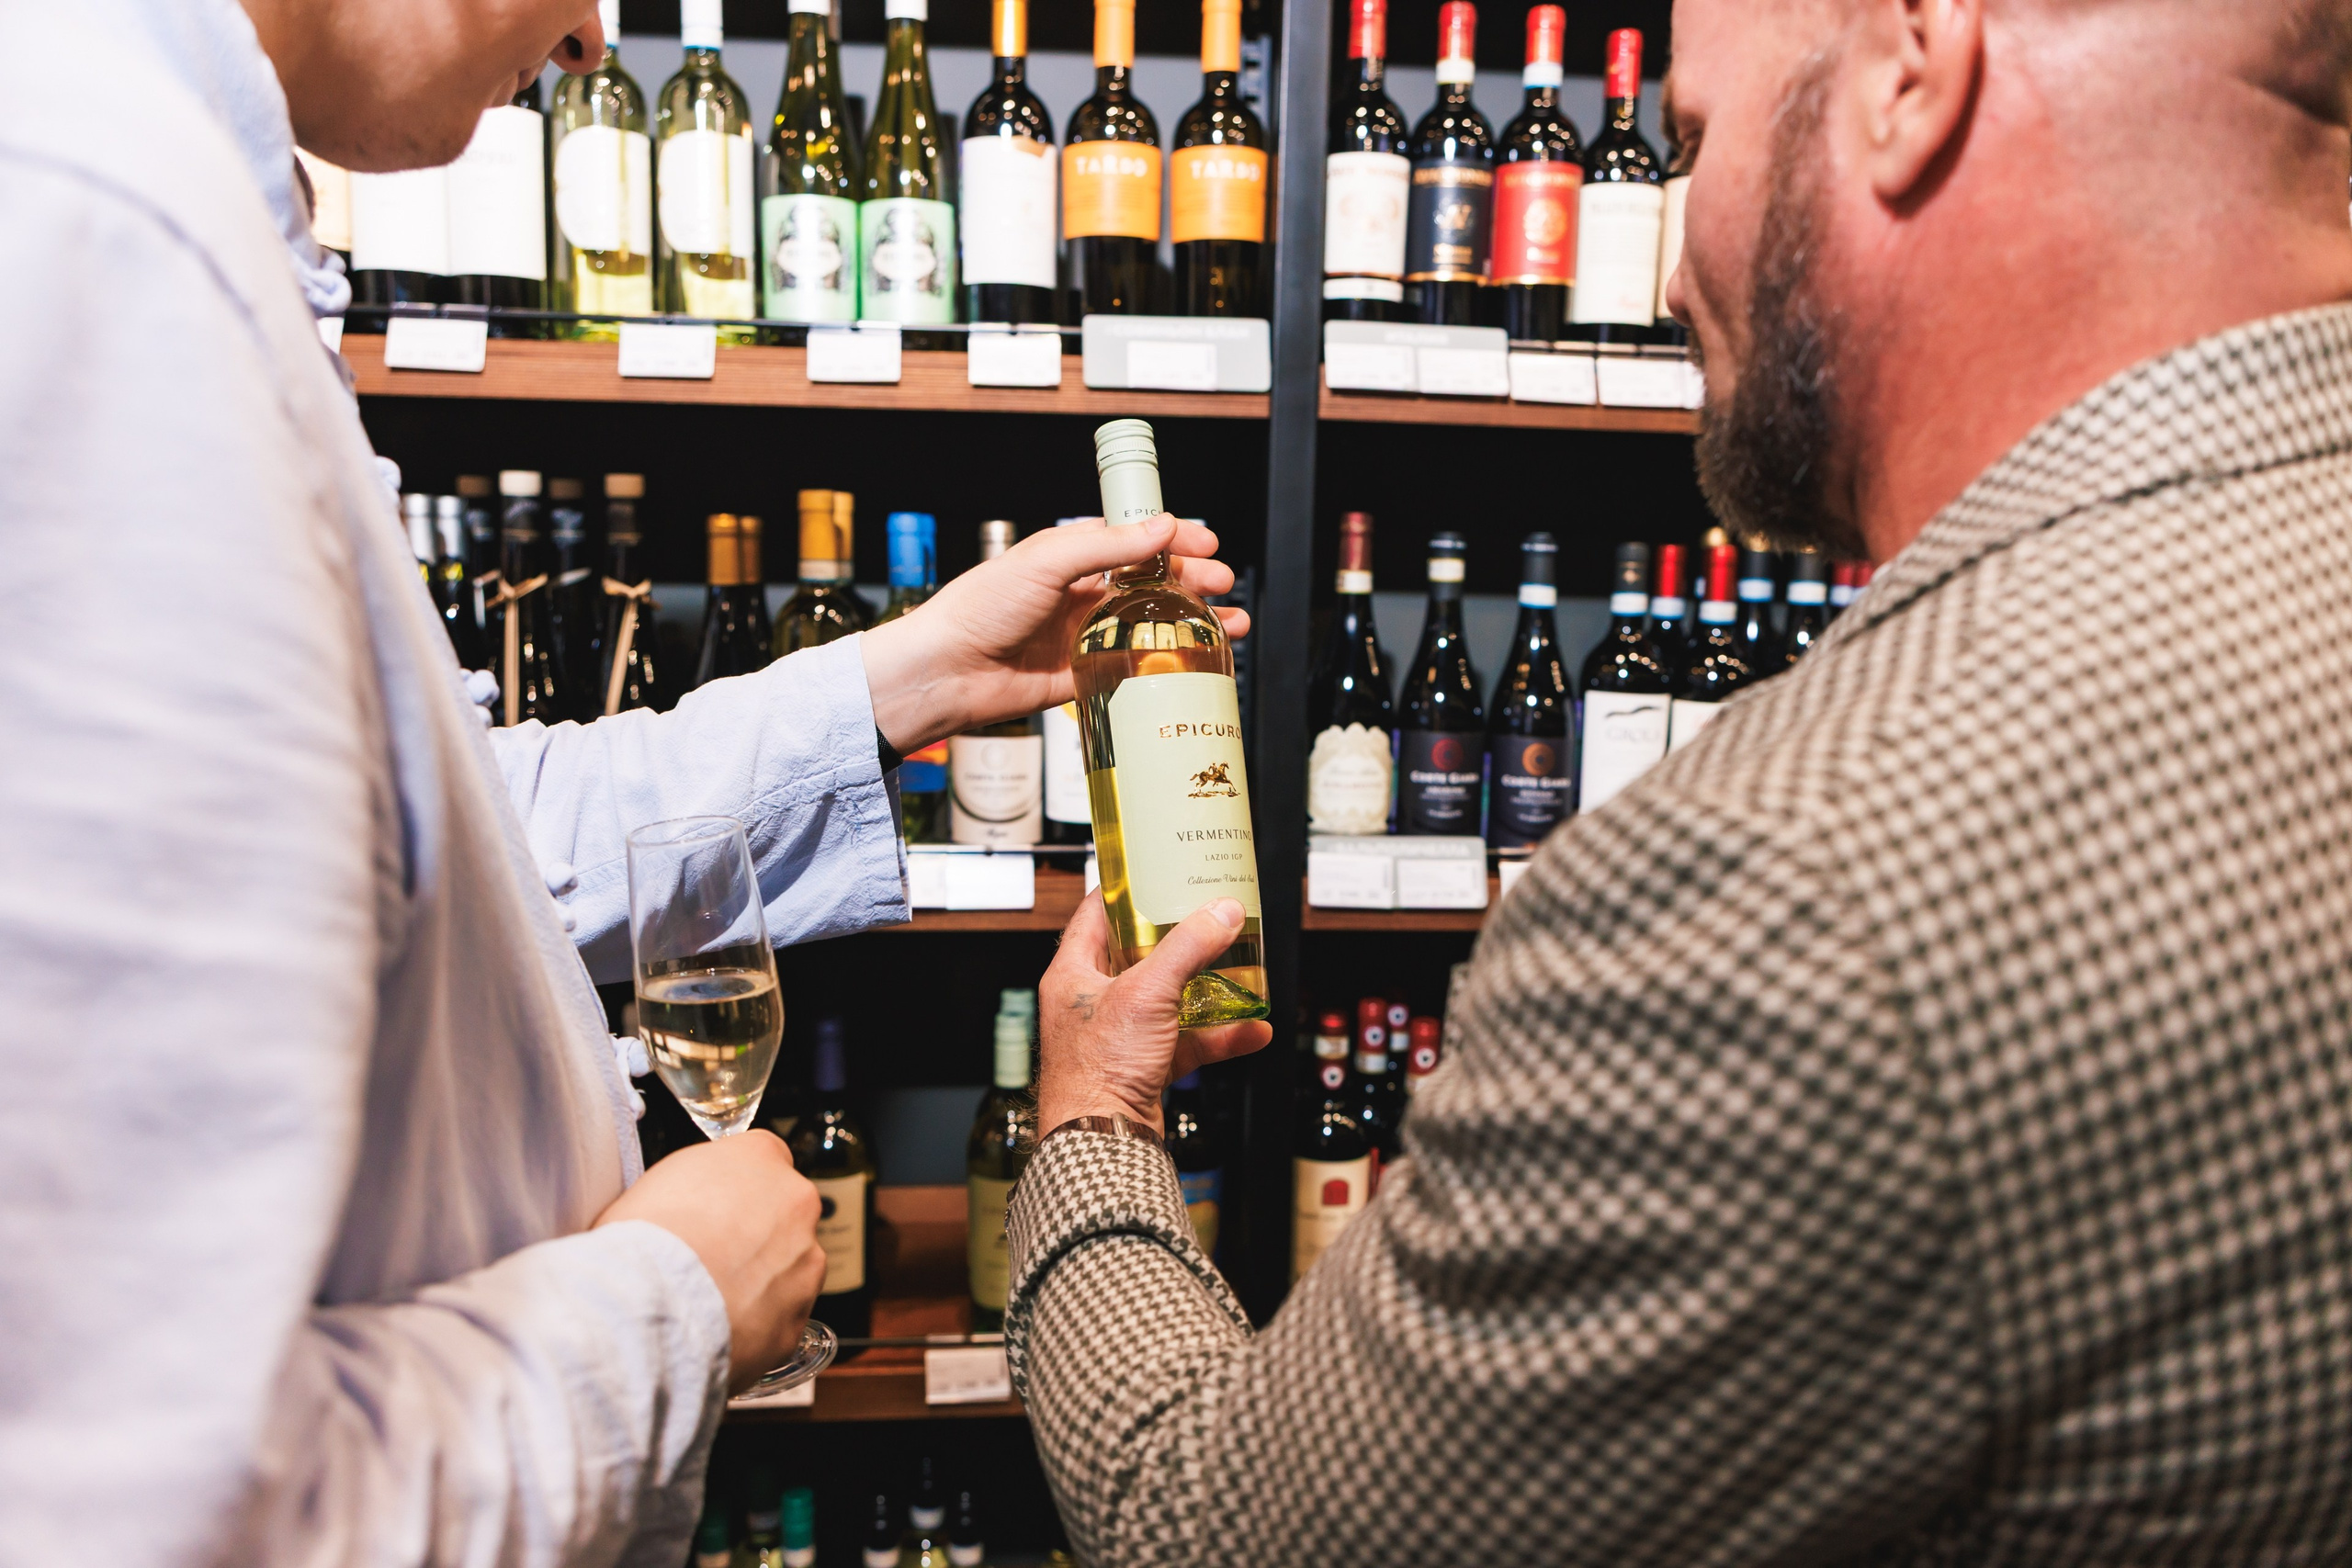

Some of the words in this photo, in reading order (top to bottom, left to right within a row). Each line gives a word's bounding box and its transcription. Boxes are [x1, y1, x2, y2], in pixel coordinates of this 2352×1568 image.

[1159, 723, 1241, 739] EPICURO
[1176, 829, 1252, 842] VERMENTINO
[1204, 853, 1229, 862] LAZIO
[1187, 875, 1222, 886] Collezione
